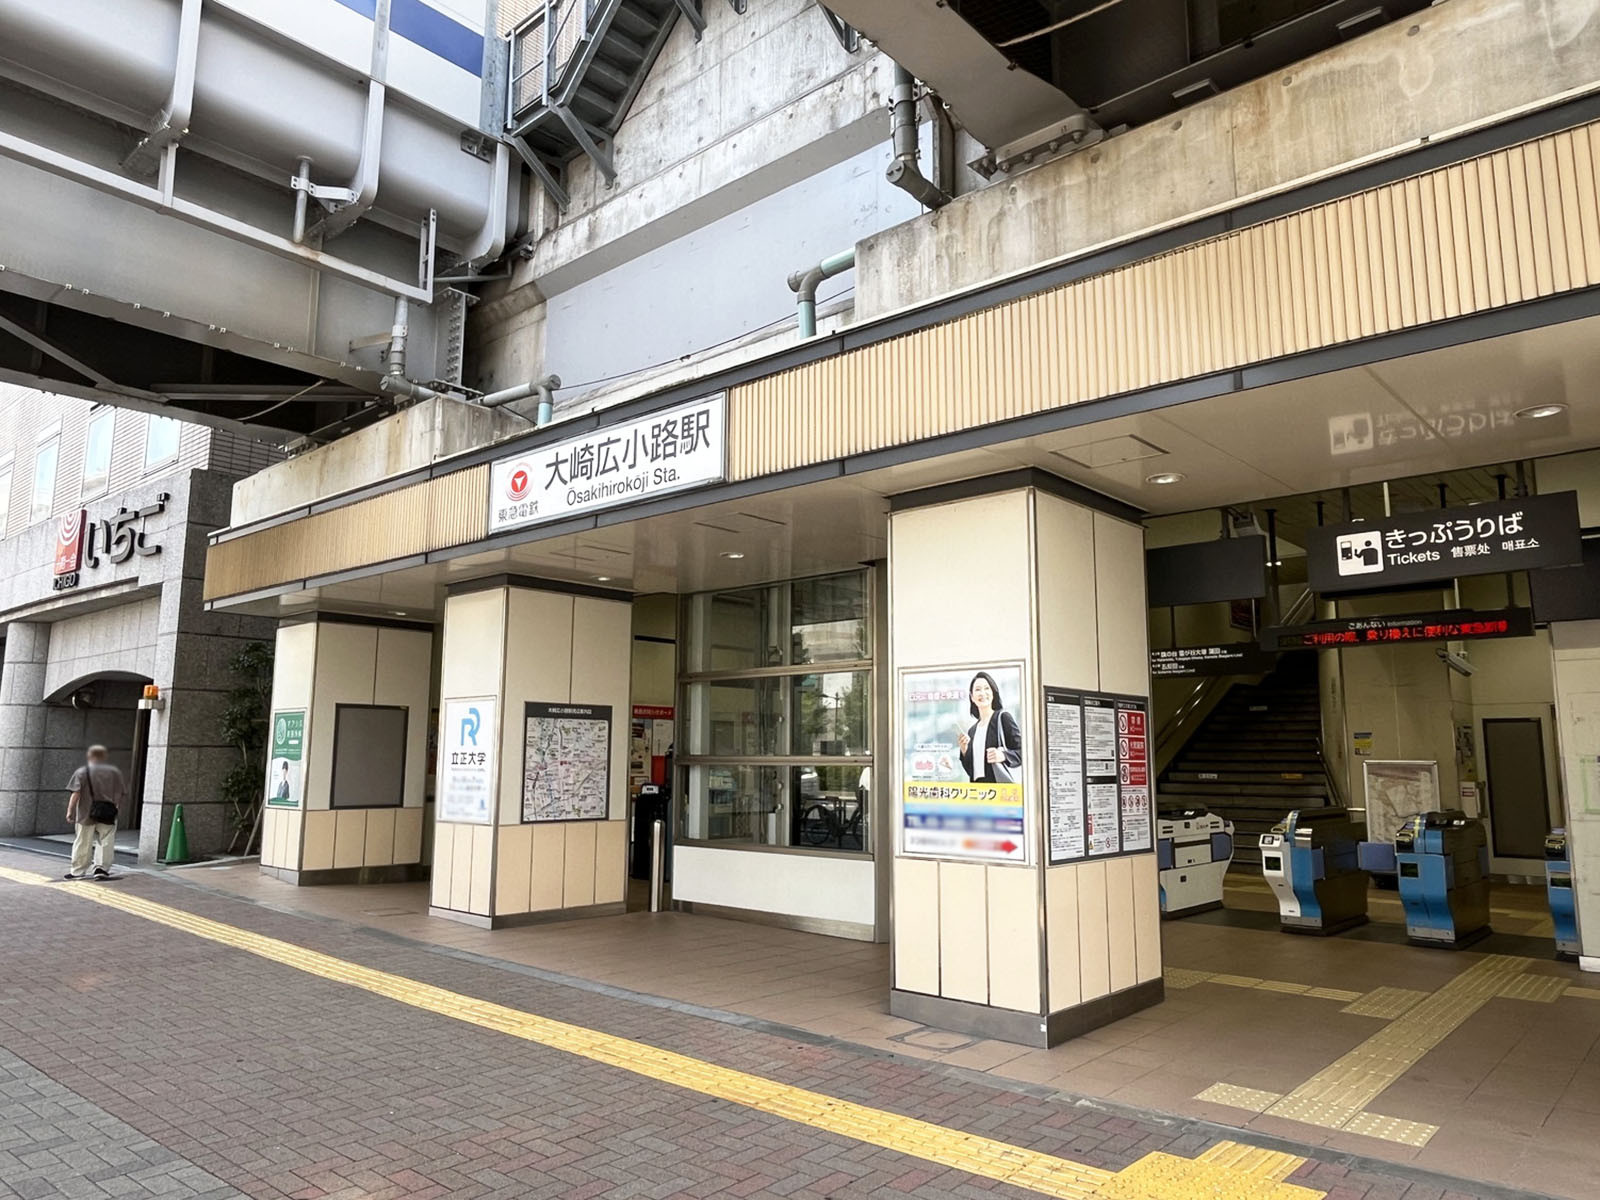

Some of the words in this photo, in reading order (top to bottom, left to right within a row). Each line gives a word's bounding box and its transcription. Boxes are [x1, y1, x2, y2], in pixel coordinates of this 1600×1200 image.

[544, 408, 711, 491] 大崎広小路駅
[566, 470, 650, 506] Ōsakihirokōji
[653, 466, 681, 487] Sta.
[84, 492, 170, 569] いちご
[1385, 511, 1524, 549] きっぷうりば
[1450, 543, 1491, 558] 售票处
[1502, 537, 1541, 552] 매표소
[1387, 550, 1441, 566] Tickets
[451, 752, 486, 766] 立正大学
[908, 786, 997, 801] 陽光歯科クリニック
